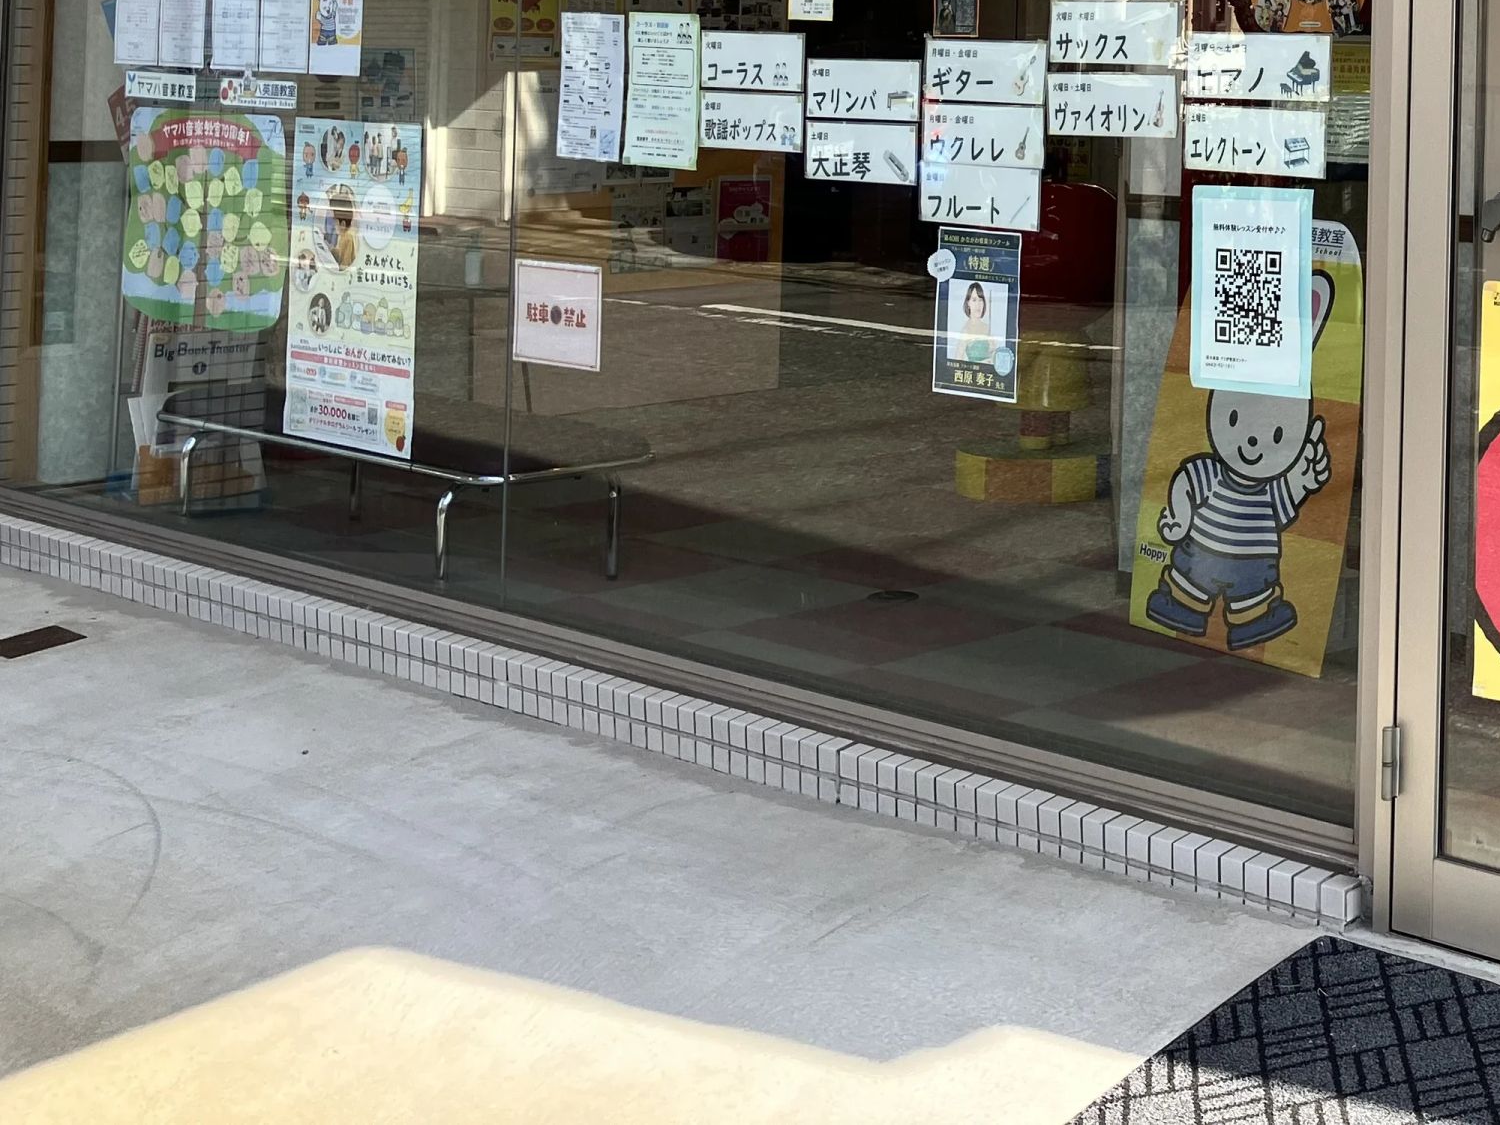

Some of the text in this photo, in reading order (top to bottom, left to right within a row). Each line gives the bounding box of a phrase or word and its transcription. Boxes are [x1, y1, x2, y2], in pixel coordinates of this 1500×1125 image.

[1056, 12, 1073, 21] 火曜日
[705, 41, 722, 50] 火曜日
[1056, 32, 1129, 60] サックス
[707, 62, 764, 85] コーラス
[812, 68, 830, 77] 水曜日
[932, 67, 994, 95] ギター
[137, 81, 193, 99] ヤマハ音楽教室
[813, 88, 877, 114] マリンバ
[705, 102, 721, 110] 金曜日
[1054, 101, 1146, 132] ヴァイオリン
[704, 119, 777, 141] 歌謡ポップス
[811, 132, 828, 140] 土曜日
[930, 135, 1005, 162] ウクレレ
[1190, 137, 1266, 166] エレクトーン
[812, 151, 871, 180] 大正琴
[927, 194, 1000, 224] フルート
[1315, 247, 1342, 256] School
[526, 302, 586, 328] 駐車 禁止
[154, 343, 175, 362] Big
[954, 370, 973, 384] 西原
[1139, 543, 1167, 563] Hoppy
